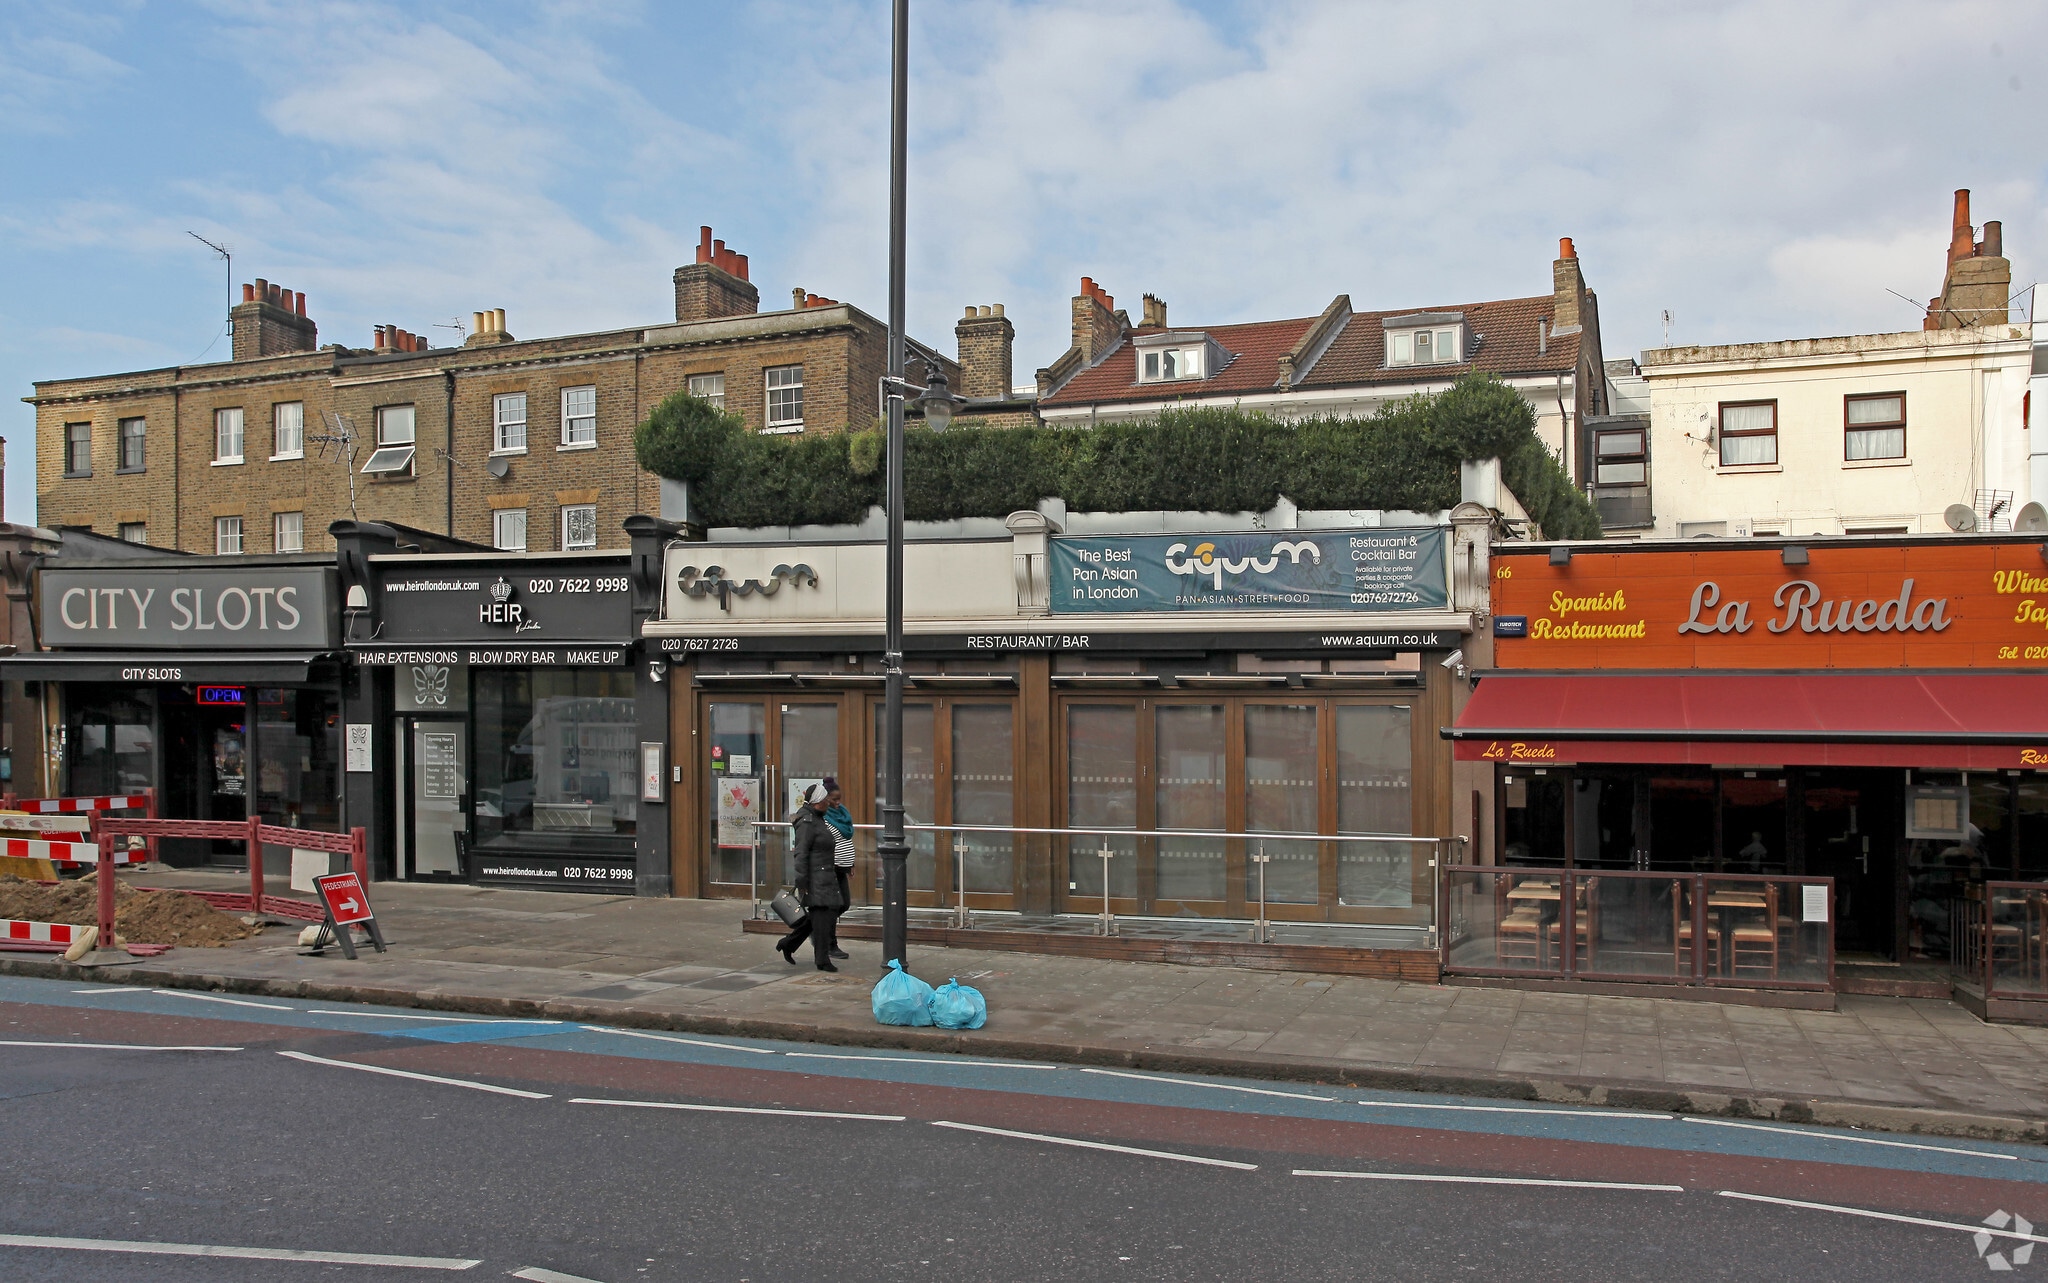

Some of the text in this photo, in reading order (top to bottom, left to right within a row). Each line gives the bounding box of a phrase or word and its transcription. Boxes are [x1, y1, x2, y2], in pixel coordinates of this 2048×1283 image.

[1350, 536, 1418, 548] Restaurant &
[1078, 548, 1131, 563] The Best
[1351, 549, 1416, 561] Cocktail Bar
[1165, 540, 1321, 591] aquum
[1392, 565, 1413, 573] private
[1073, 567, 1137, 582] Pan Asian
[1355, 574, 1376, 582] parties
[1382, 574, 1413, 582] corporate
[1496, 566, 1511, 580] 66
[529, 577, 629, 593] 020 7622 9998
[677, 563, 819, 612] aquum
[1364, 582, 1392, 590] bookings
[1992, 569, 2048, 594] Wine
[1072, 585, 1139, 599] in London
[1350, 592, 1419, 604] 02076272726
[61, 586, 301, 631] CITY SLOTS
[1549, 589, 1627, 619] Spanish
[1677, 578, 1952, 634] La Rueda
[479, 603, 522, 623] HEIR
[1530, 618, 1646, 641] Restaurant
[661, 637, 739, 651] 020 7627 2726
[1321, 633, 1438, 647] www.aquum.co.uk
[359, 651, 619, 664] HAIR EXTENSIONS BLOW DRY BAR MAKE UP
[1998, 645, 2048, 660] Tel 020
[122, 668, 182, 680] CITY SLOTS
[205, 688, 241, 702] OPEN
[1482, 741, 1556, 759] La Rueda
[563, 866, 581, 878] 020
[584, 867, 607, 879] 7622
[610, 868, 633, 880] 9998
[323, 879, 358, 891] PEDESTRIANS
